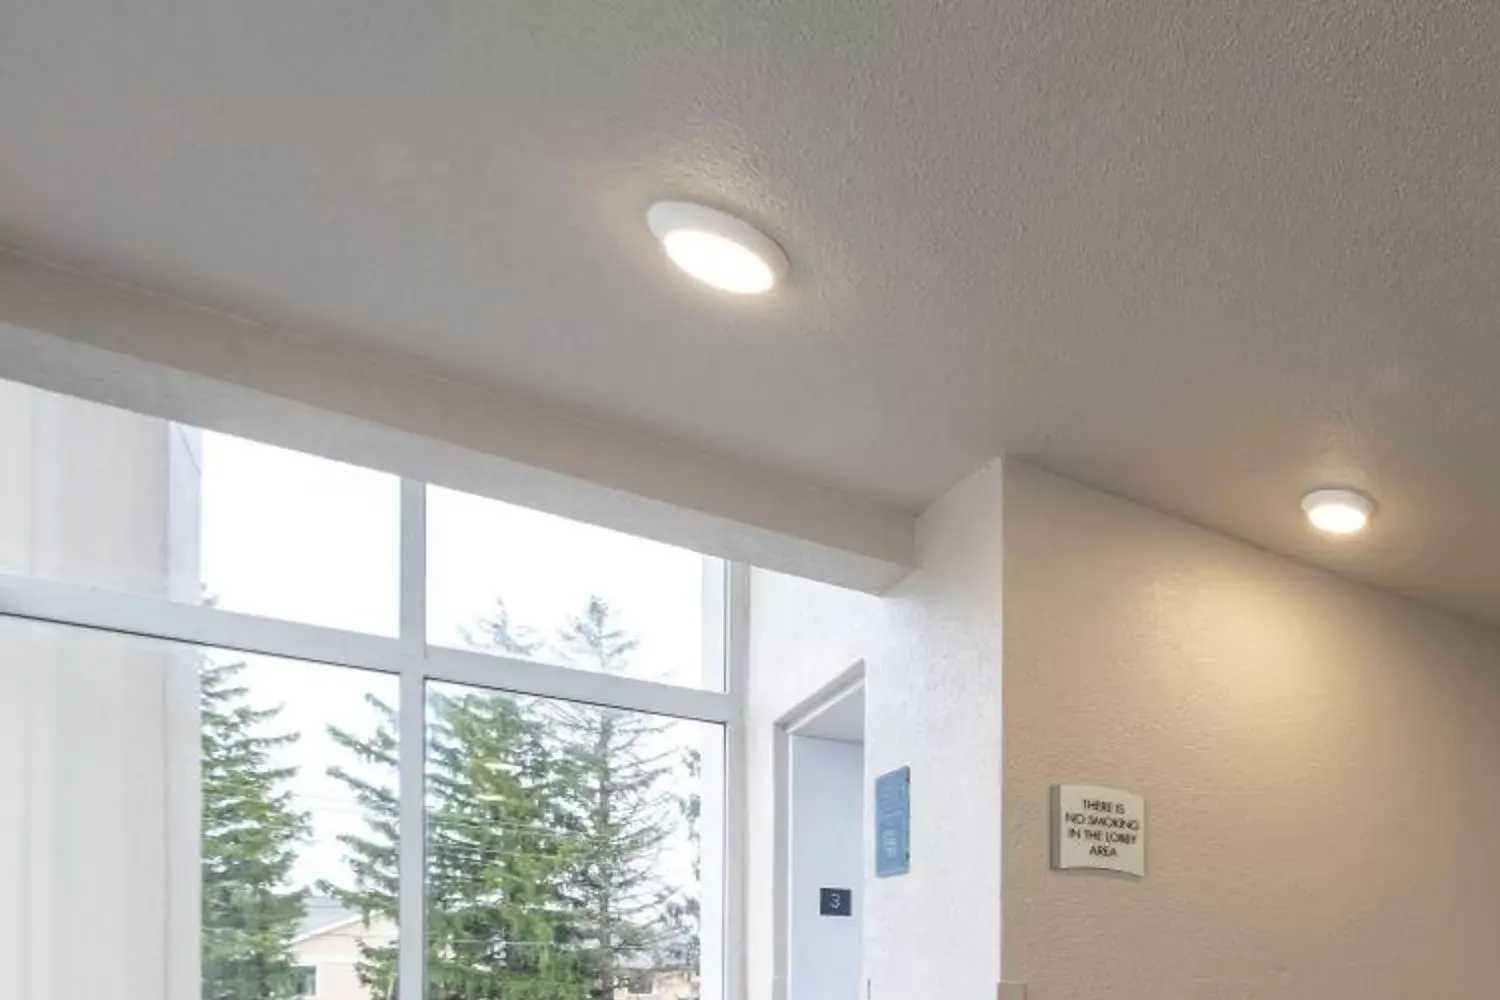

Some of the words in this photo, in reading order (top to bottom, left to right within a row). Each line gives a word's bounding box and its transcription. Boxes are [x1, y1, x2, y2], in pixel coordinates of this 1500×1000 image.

[1082, 799, 1112, 813] THERE
[1115, 803, 1125, 815] IS
[1065, 811, 1086, 825] NO
[1087, 814, 1140, 831] SMOKING
[1068, 827, 1081, 839] IN
[1083, 829, 1103, 841] THE
[1105, 831, 1137, 845] LOBBY
[1089, 845, 1117, 857] AREA
[830, 893, 841, 909] 3
